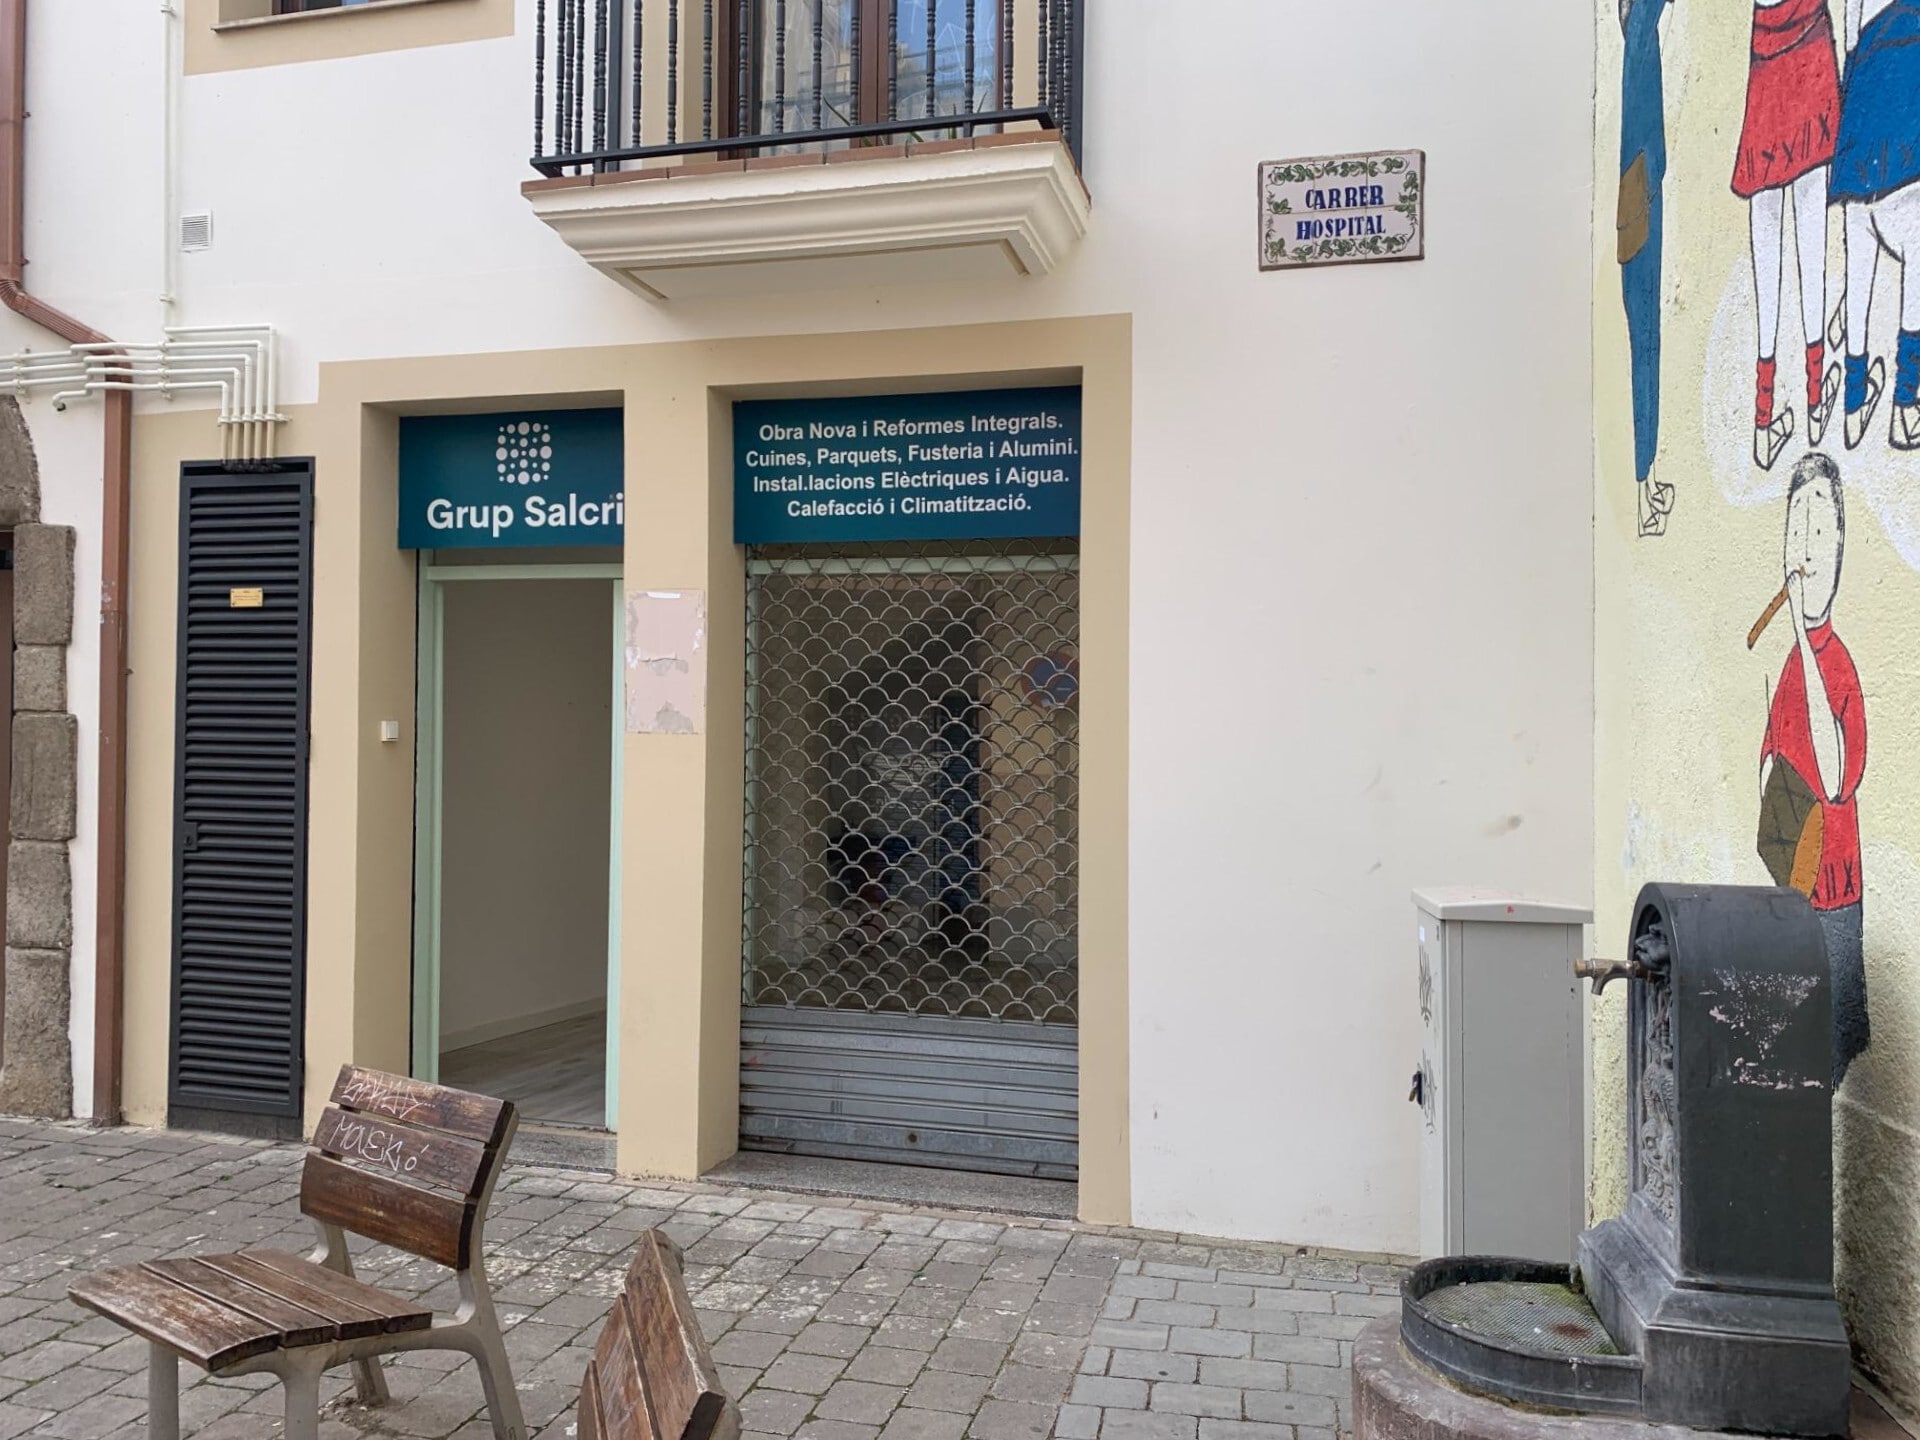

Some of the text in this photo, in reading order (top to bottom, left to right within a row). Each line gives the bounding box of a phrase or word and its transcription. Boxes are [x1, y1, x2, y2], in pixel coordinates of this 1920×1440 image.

[1305, 185, 1384, 210] CARRER
[1296, 214, 1386, 240] HOSPITAL
[759, 412, 1063, 441] Obra Nova i Reformes Integrals.
[746, 437, 1078, 468] Cuines, Parquets, Fusteria i Alumini.
[753, 466, 1069, 493] Instal.lacions Elèctriques i Aigua.
[427, 492, 624, 538] Grup Salcri
[787, 493, 1031, 517] Calefacció i Climatització.
